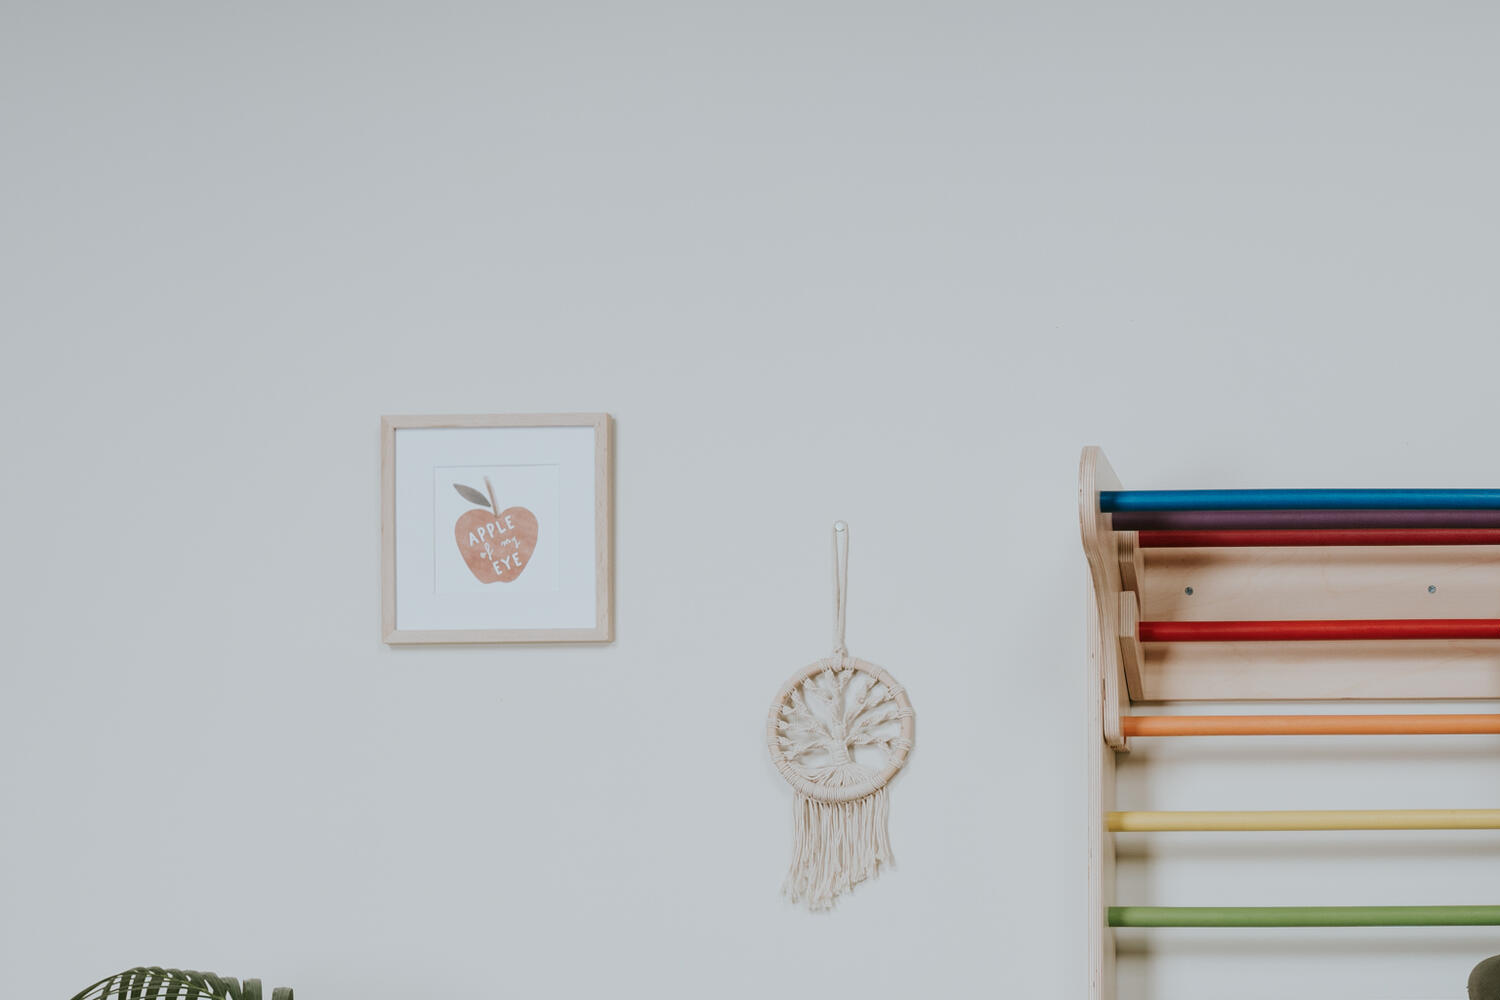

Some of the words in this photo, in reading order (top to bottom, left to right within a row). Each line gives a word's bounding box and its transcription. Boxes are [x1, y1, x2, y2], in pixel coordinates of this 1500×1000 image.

[469, 515, 515, 547] APPLE
[480, 542, 494, 561] of
[493, 552, 522, 575] EYE
